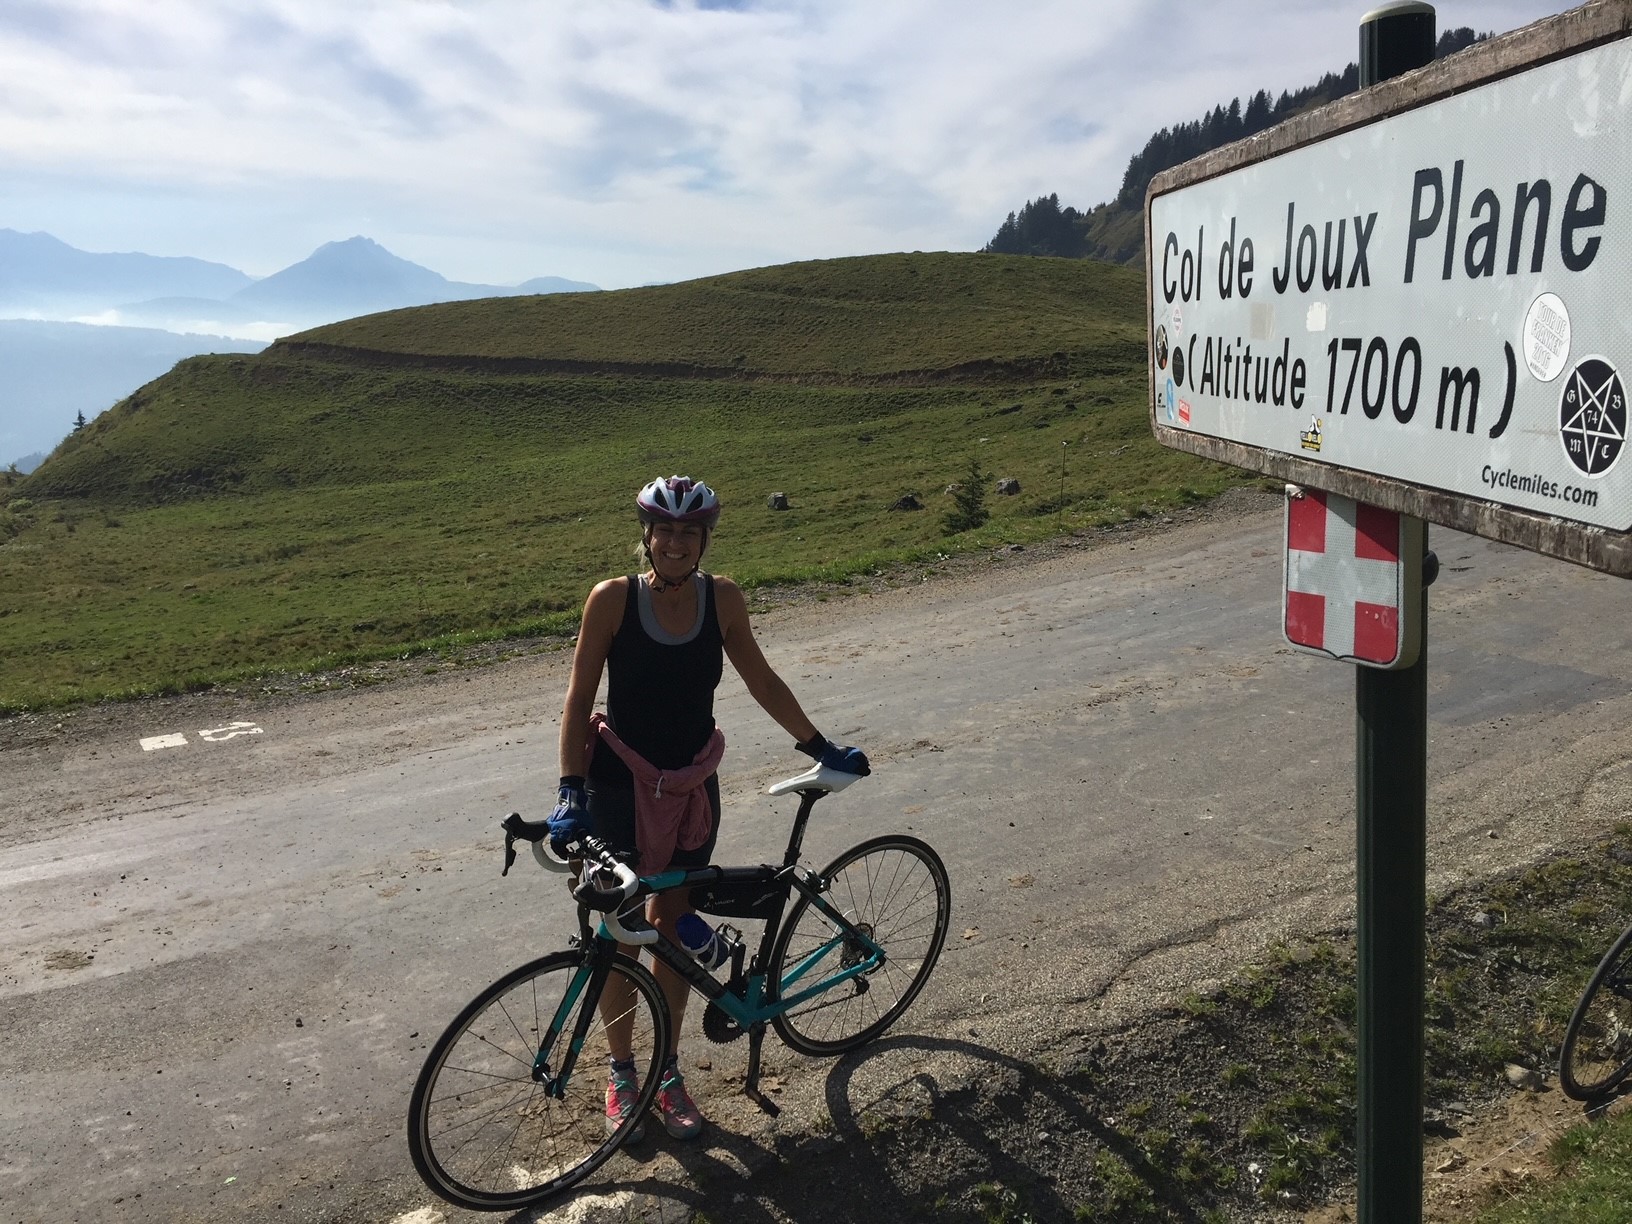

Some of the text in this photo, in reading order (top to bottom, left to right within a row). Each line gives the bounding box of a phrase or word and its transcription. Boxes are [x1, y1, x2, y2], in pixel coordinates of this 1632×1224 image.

[1163, 159, 1608, 304] Col de Joux Plane
[1326, 336, 1423, 424] 1700
[1586, 409, 1598, 424] 74
[1481, 464, 1599, 507] Cyclemiles.com
